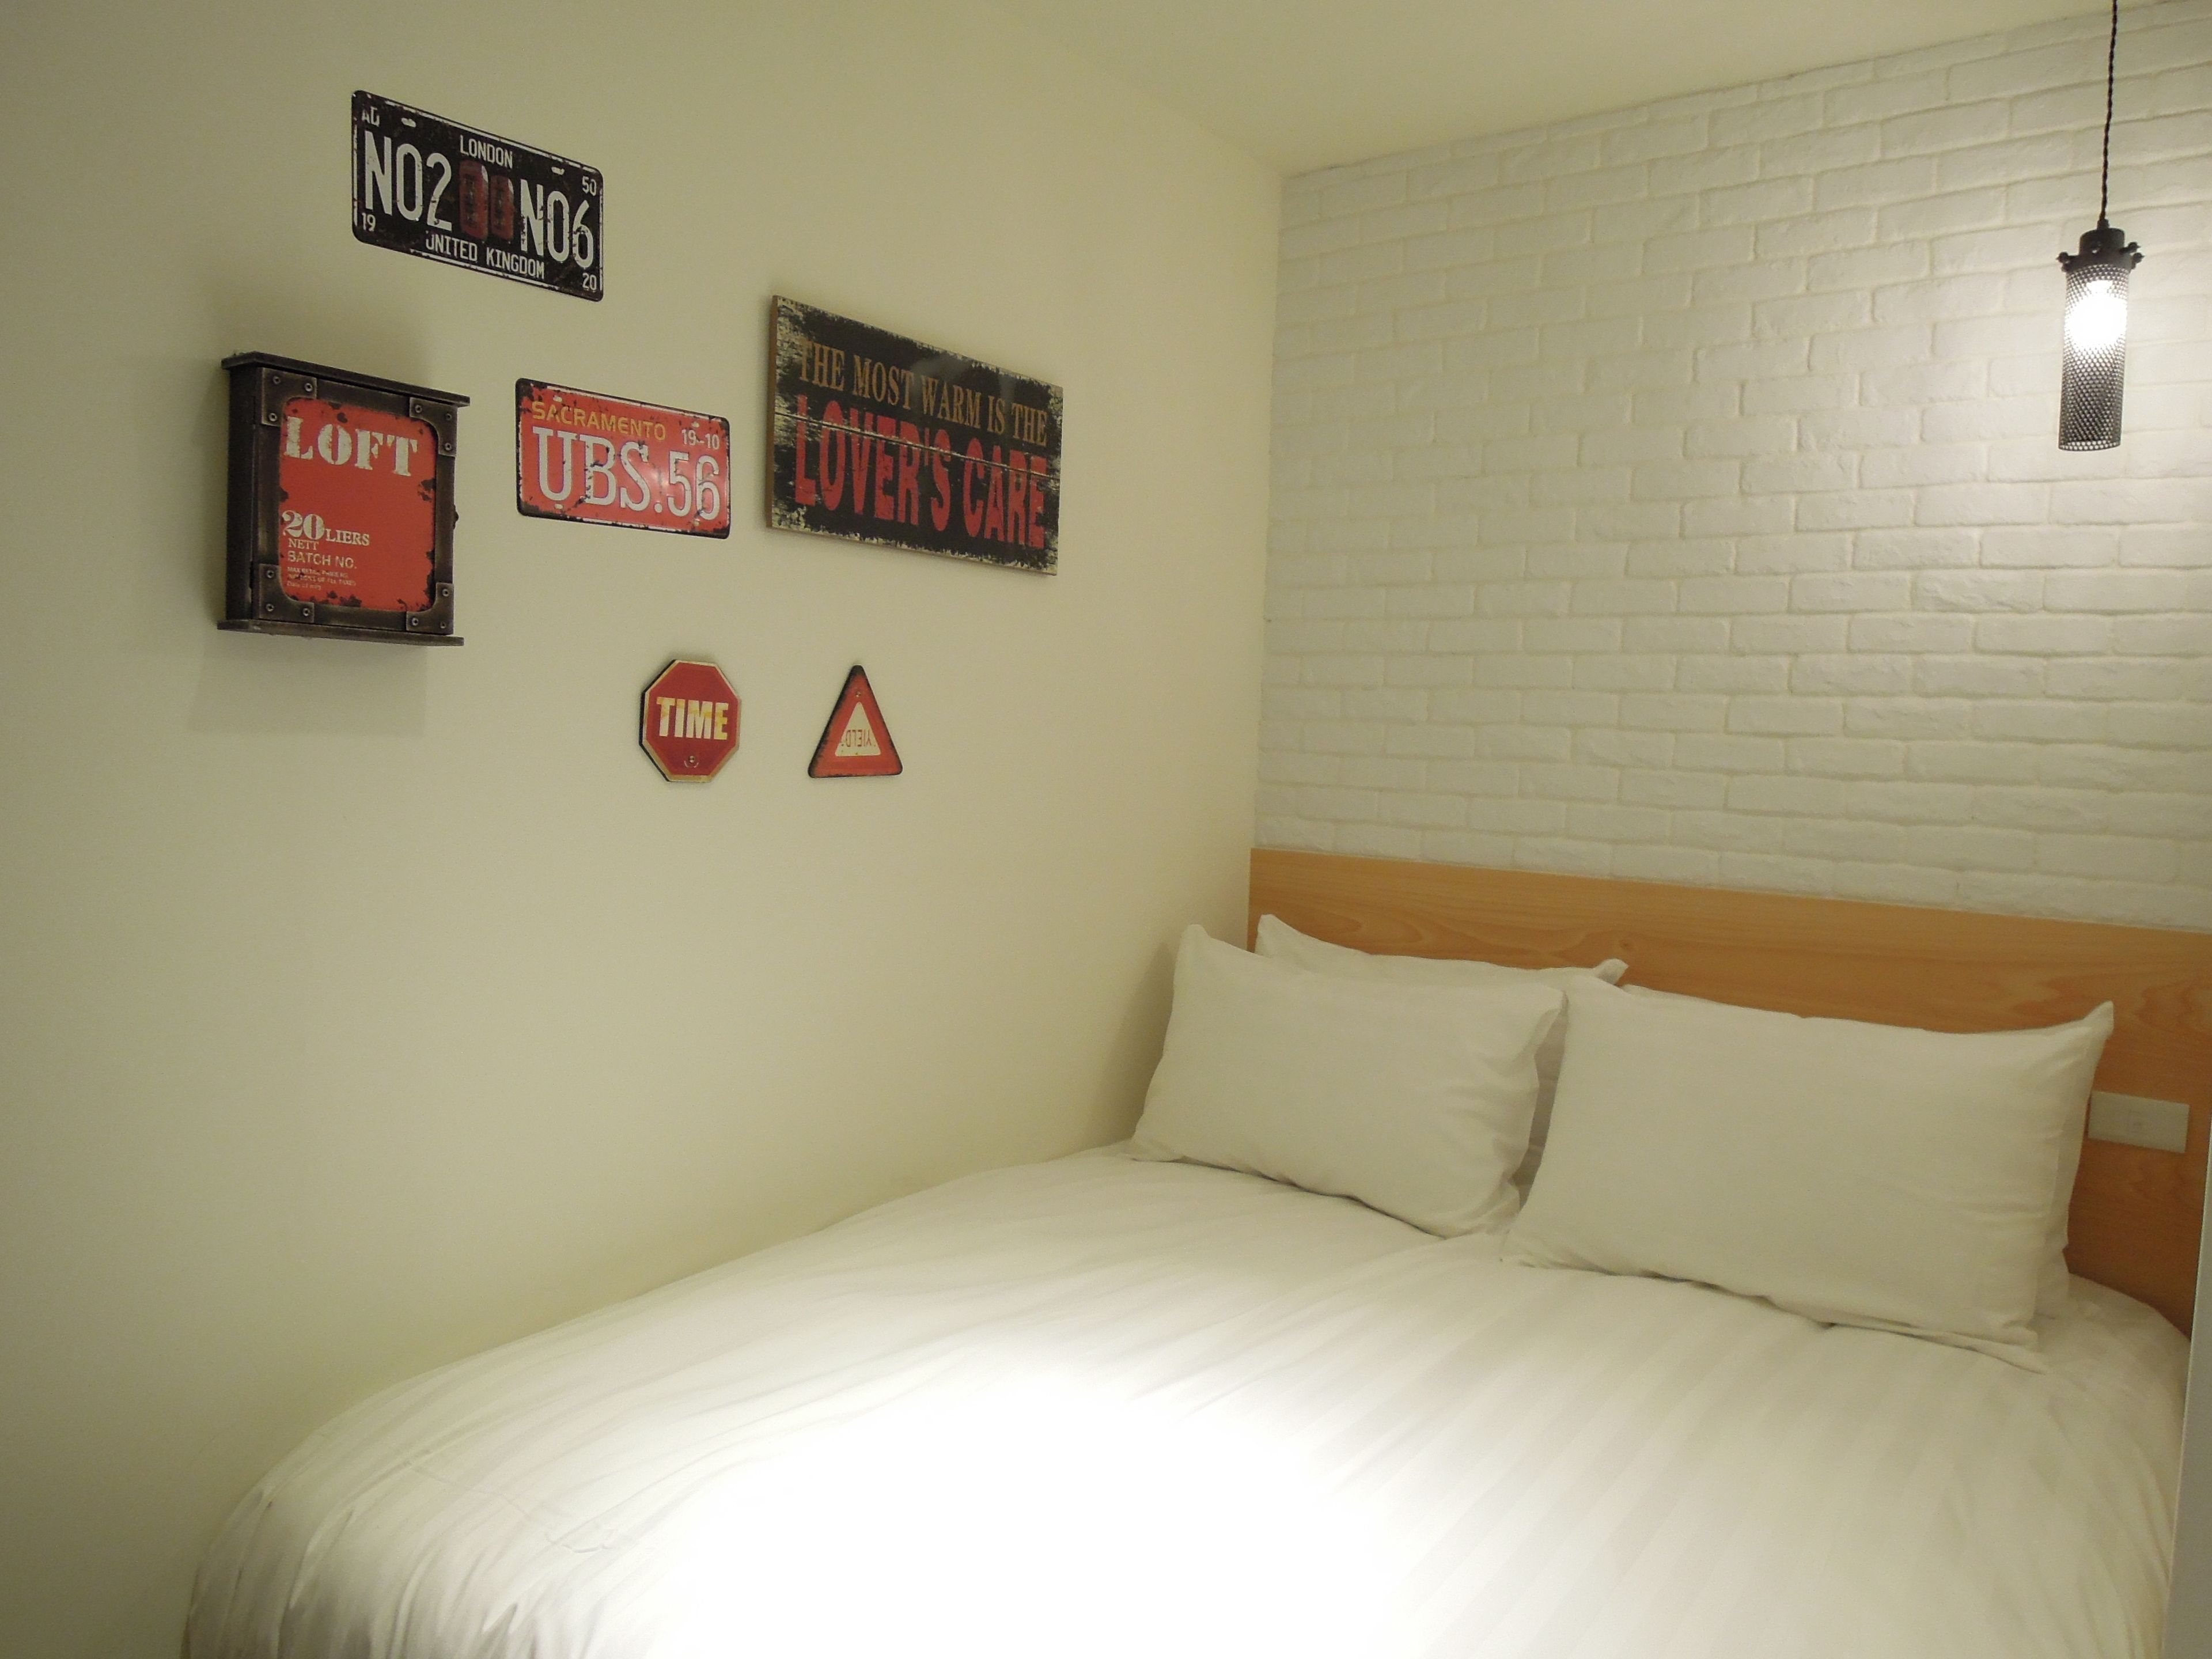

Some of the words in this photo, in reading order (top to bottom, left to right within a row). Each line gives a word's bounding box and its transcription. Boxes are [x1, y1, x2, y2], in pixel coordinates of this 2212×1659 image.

[460, 134, 514, 169] LONDON
[364, 130, 452, 232] NO2
[581, 176, 597, 197] 50
[361, 211, 376, 232] 19
[520, 178, 594, 268] NO6
[425, 230, 478, 262] UNITED
[486, 247, 545, 280] KINGDOM
[582, 272, 597, 291] 20
[798, 340, 846, 392] THE
[851, 353, 915, 411] MOST
[921, 374, 982, 429] WARM
[986, 395, 1006, 435] IS
[1010, 402, 1048, 447] THE
[531, 400, 666, 441] SACRAMENTO
[681, 429, 720, 450] 19-10
[283, 415, 419, 478] LOFT
[532, 426, 721, 521] UBS.56
[794, 393, 952, 532] LOVER'S
[963, 437, 1048, 549] CARE
[288, 537, 319, 551] NETT
[288, 550, 331, 566] BATCH
[656, 696, 729, 740] TIME
[845, 729, 872, 747] YIELD
